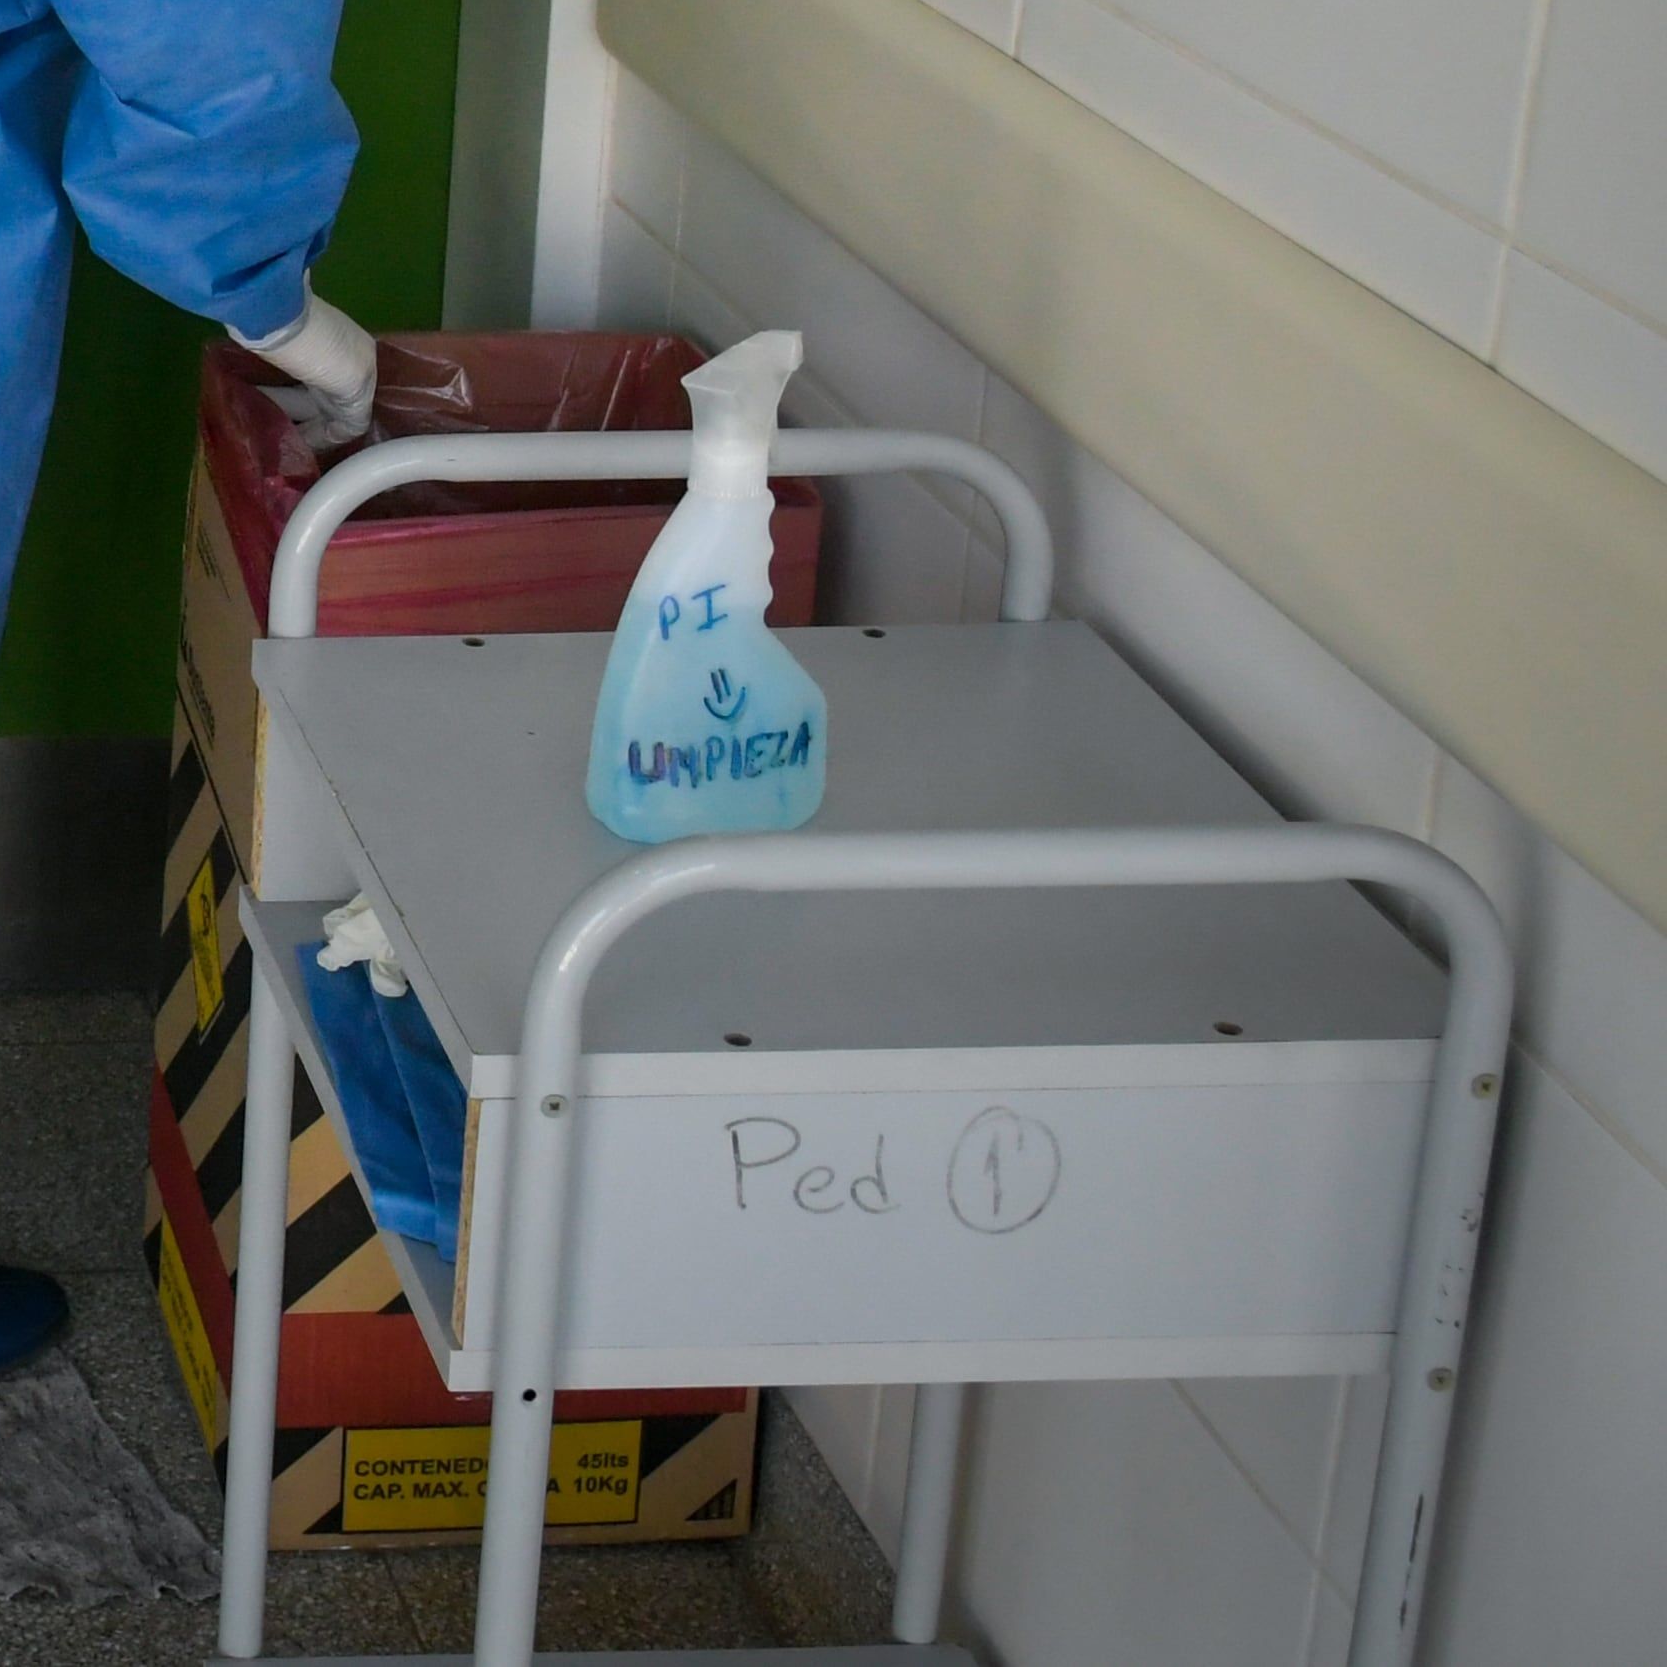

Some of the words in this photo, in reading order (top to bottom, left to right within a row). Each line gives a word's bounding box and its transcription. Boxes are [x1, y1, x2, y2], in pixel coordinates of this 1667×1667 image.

[724, 1115, 902, 1215] Ped
[353, 1481, 406, 1501] CAP.
[412, 1480, 470, 1498] MAX.
[573, 1476, 629, 1496] 10Kg
